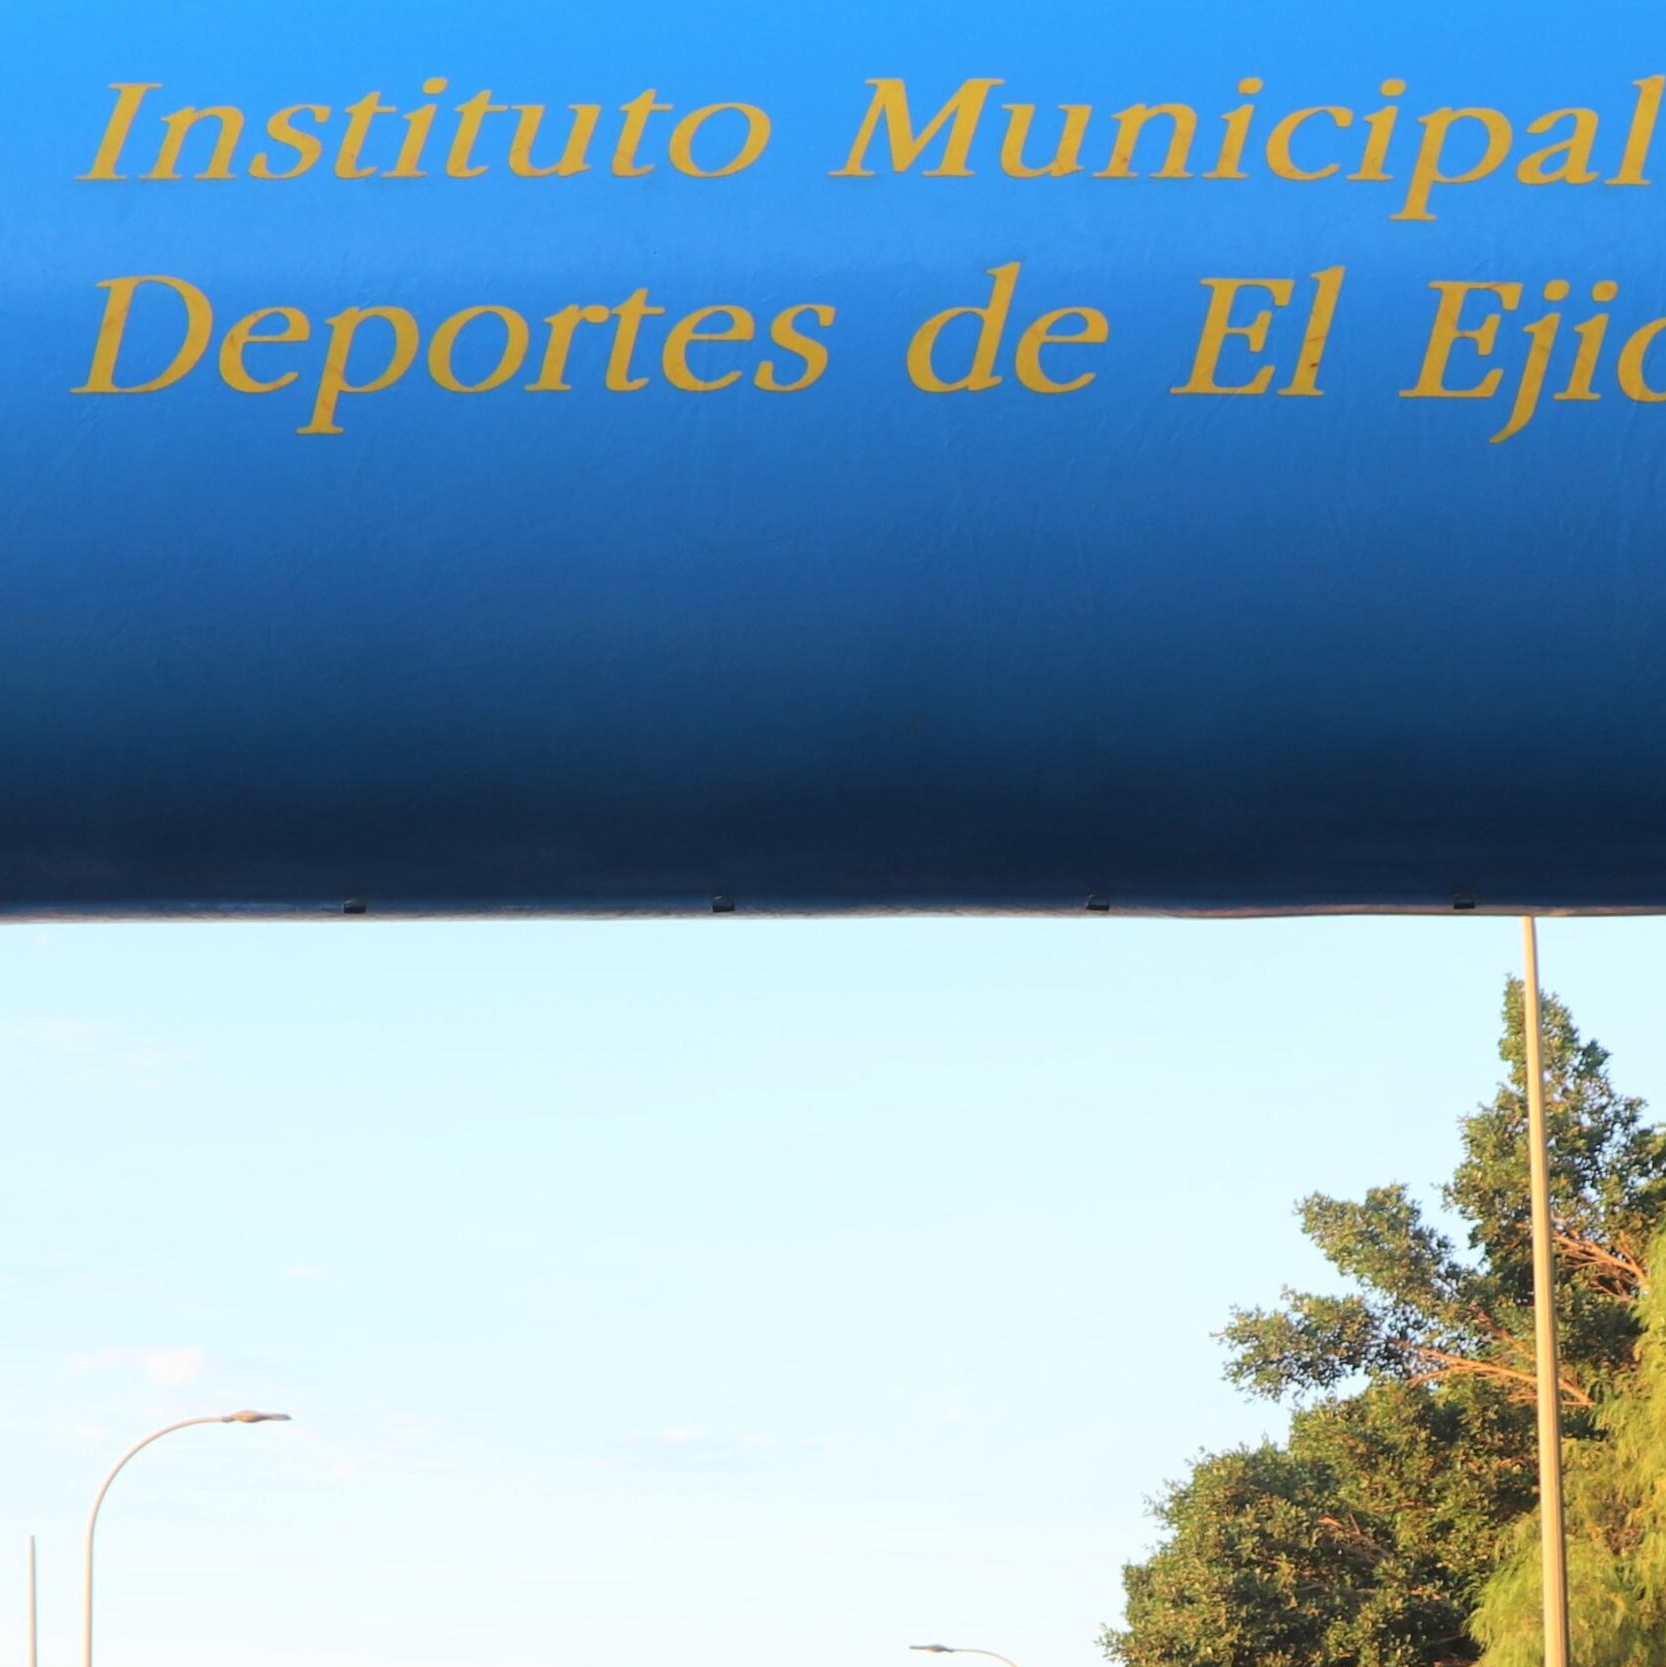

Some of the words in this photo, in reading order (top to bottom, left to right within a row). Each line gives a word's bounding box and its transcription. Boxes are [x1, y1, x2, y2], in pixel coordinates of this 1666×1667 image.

[76, 78, 773, 180] Instituto
[830, 74, 1666, 221] Municipal
[70, 274, 833, 434] Deportes
[906, 263, 1109, 394] de
[1170, 267, 1345, 397] El
